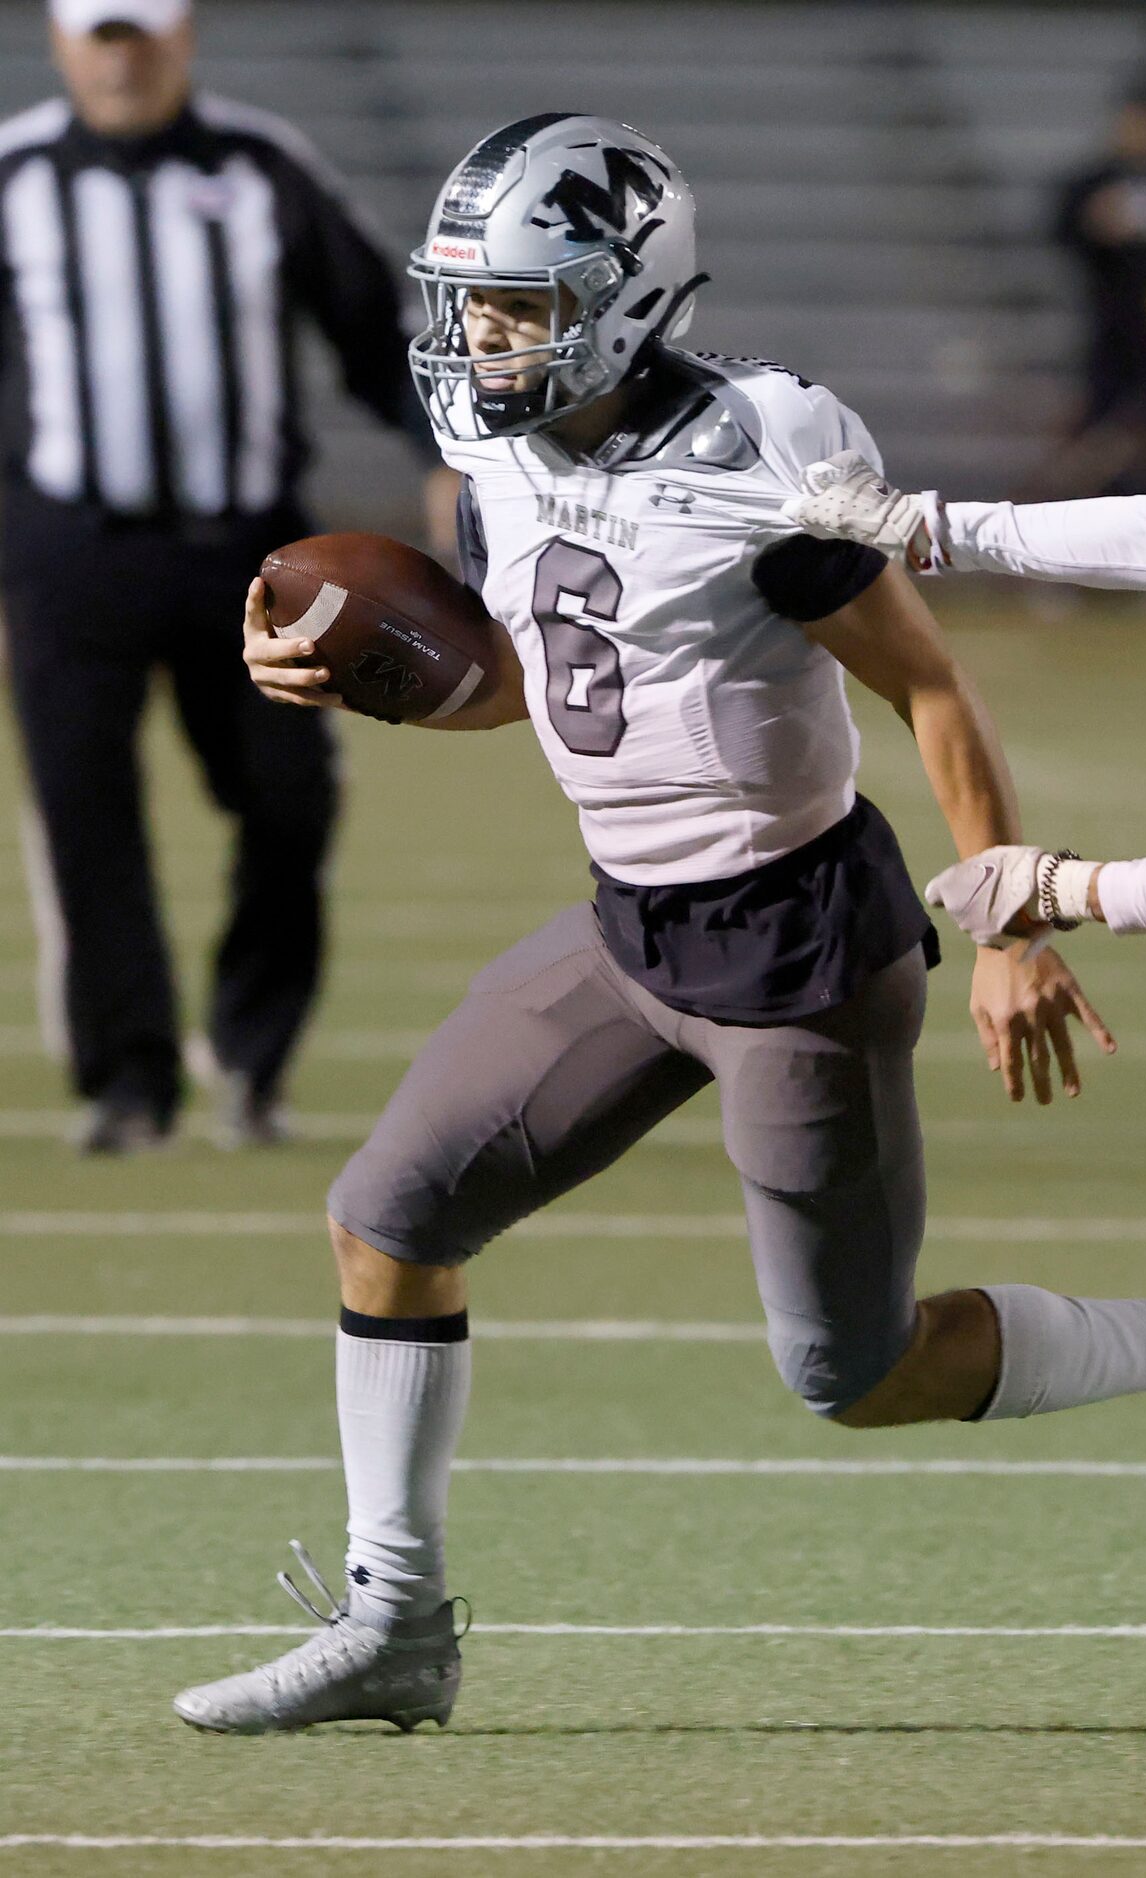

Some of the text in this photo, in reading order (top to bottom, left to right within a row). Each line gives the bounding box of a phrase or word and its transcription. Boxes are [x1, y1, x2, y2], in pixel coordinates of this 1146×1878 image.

[541, 147, 665, 243] M
[534, 493, 641, 551] MARTIN
[379, 621, 441, 661] TEAM ISSUE
[531, 535, 629, 758] 6
